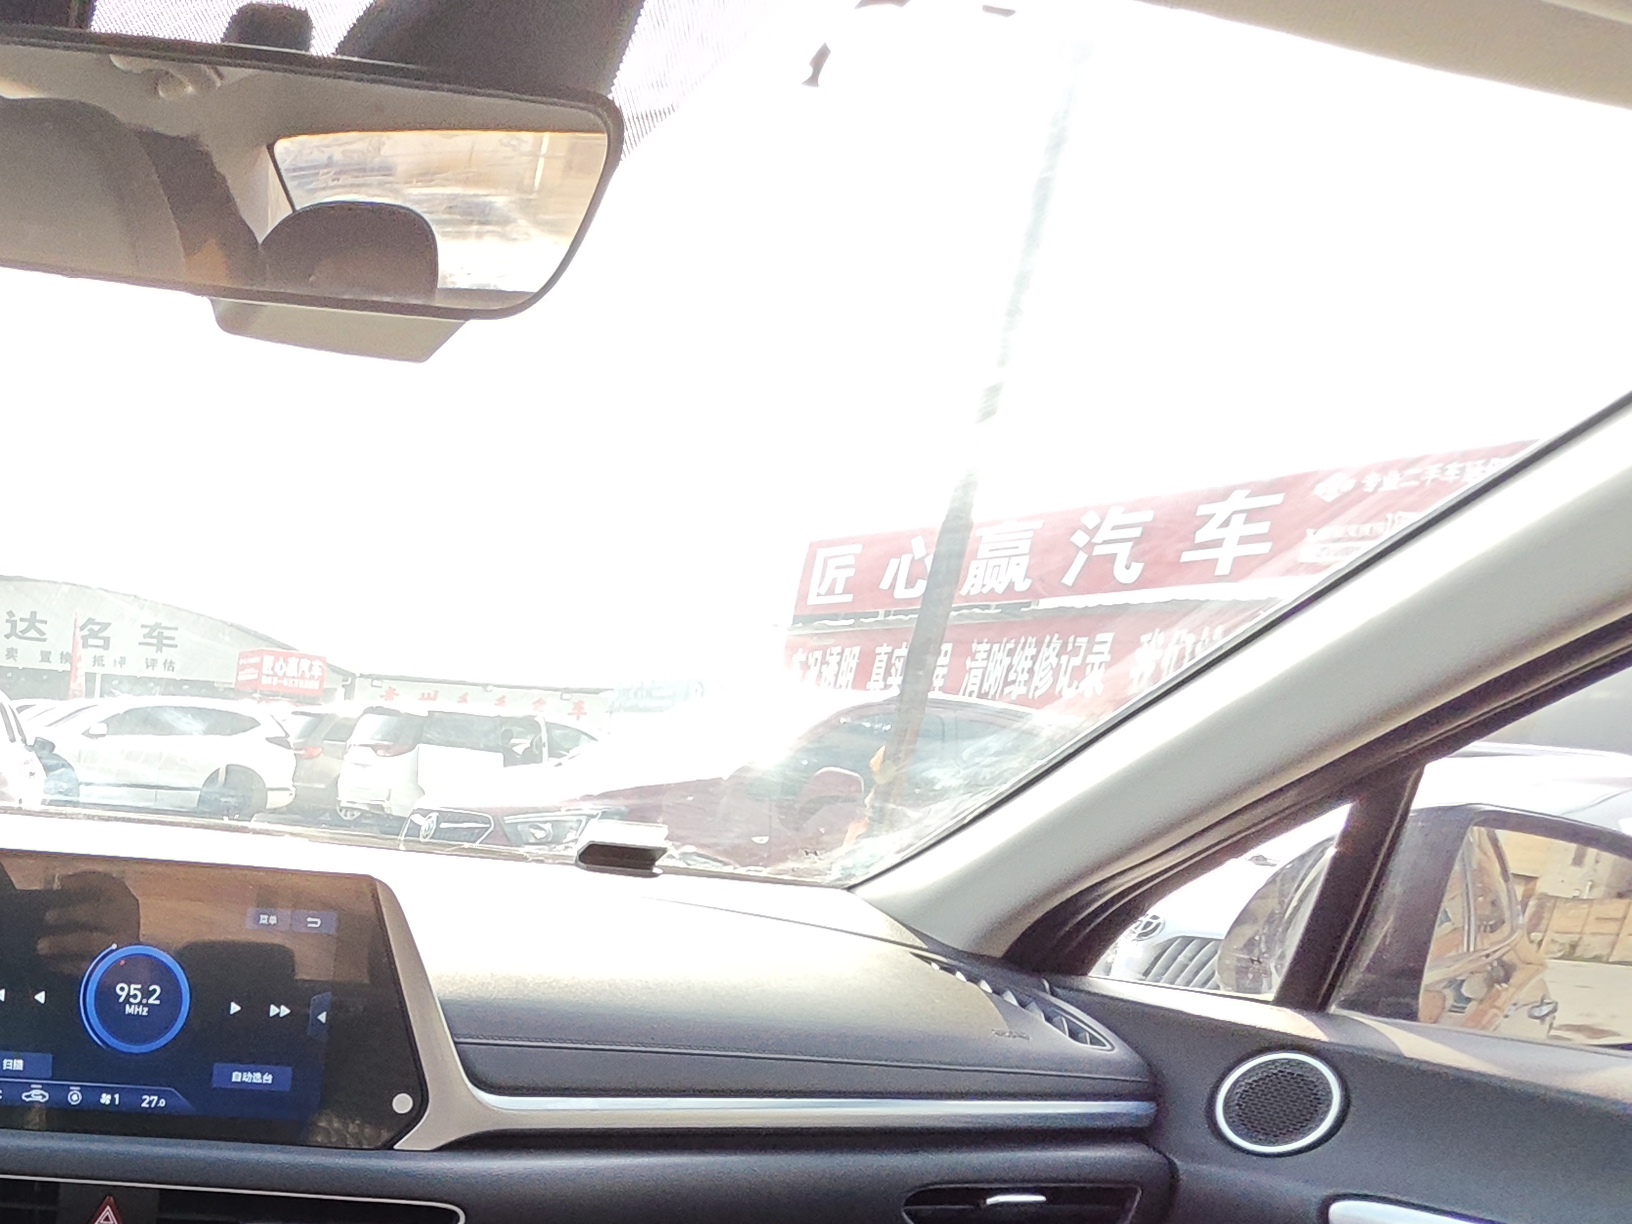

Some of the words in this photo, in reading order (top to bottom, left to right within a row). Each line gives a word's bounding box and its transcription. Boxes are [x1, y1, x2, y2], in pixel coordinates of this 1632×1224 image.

[807, 489, 1284, 605] 匠心赢汽车
[145, 657, 175, 673] 评估
[866, 642, 952, 694] 真实程
[960, 632, 1116, 700] 清晰维修记录
[115, 983, 160, 1005] 95.2
[125, 1004, 148, 1016] MHz
[2, 1059, 23, 1071] 扫描
[231, 1072, 273, 1084] 自动选台
[141, 1095, 166, 1108] 27.0
